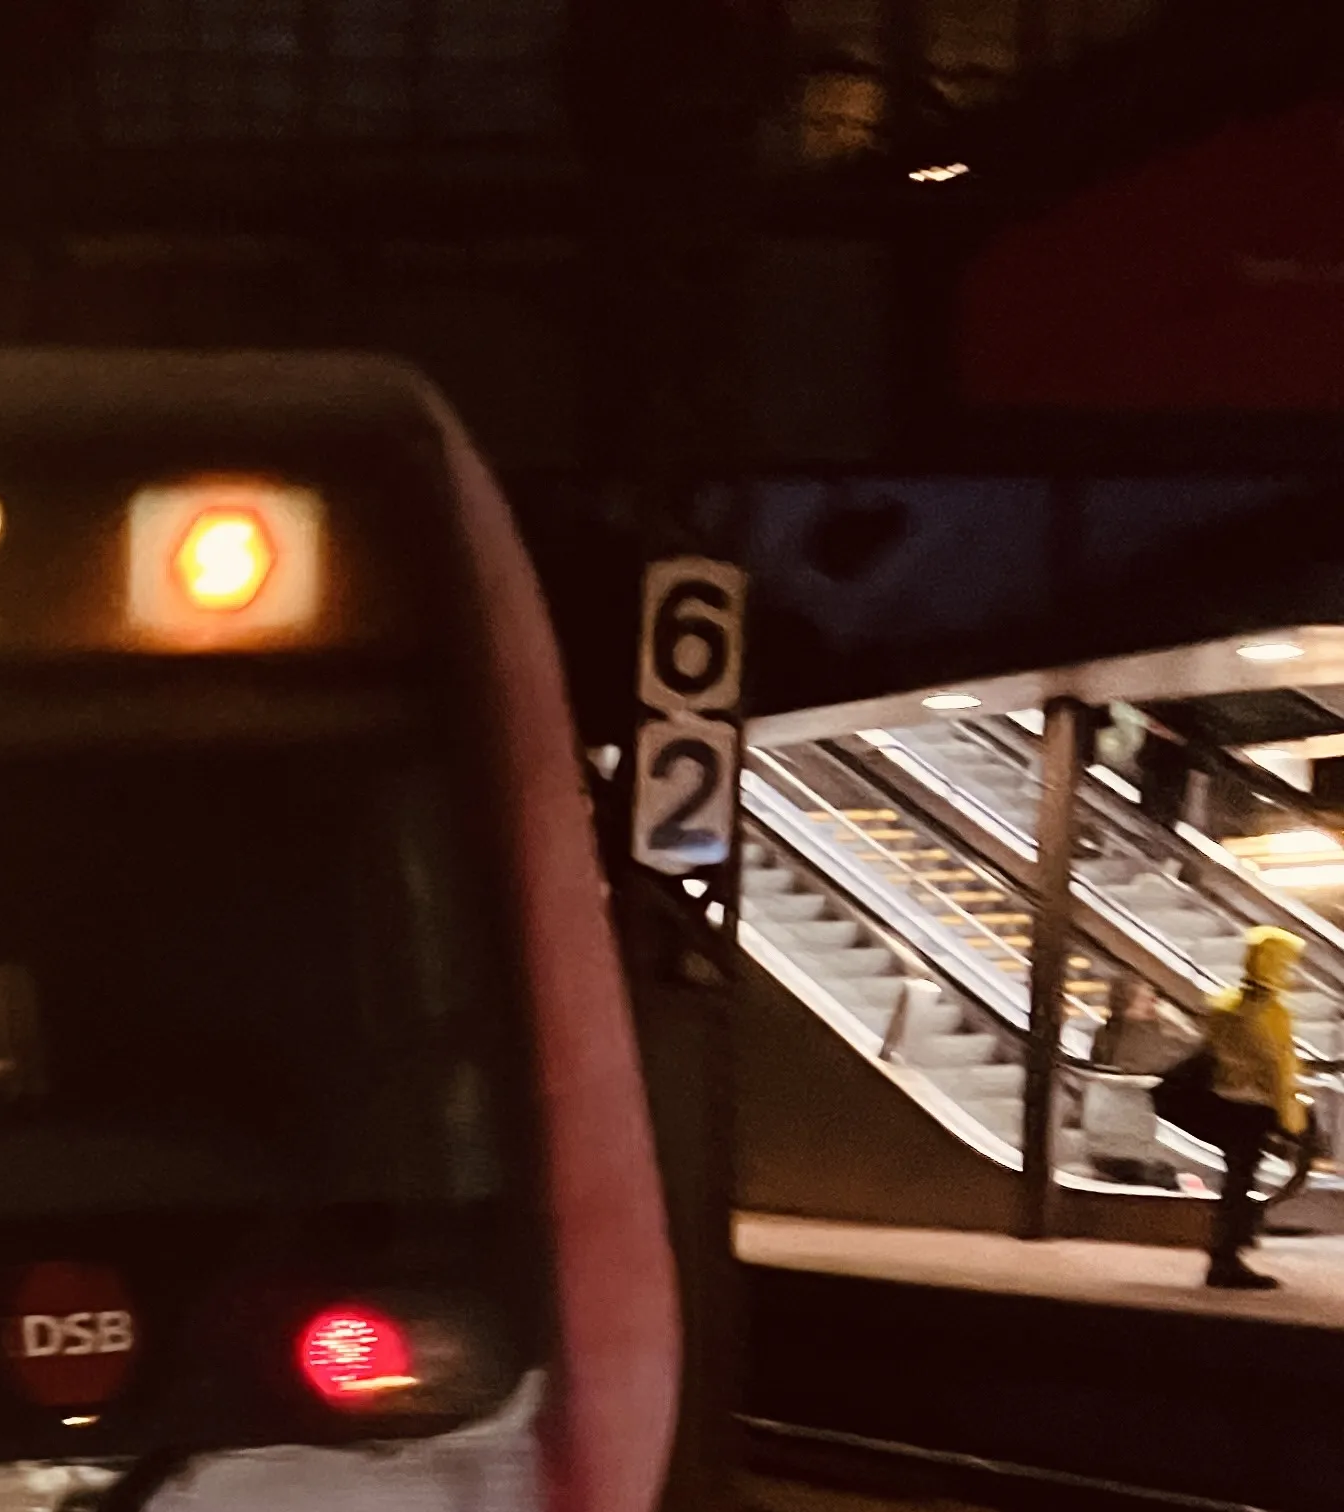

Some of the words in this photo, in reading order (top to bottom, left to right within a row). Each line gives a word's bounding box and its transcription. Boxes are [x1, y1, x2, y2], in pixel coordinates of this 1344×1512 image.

[653, 579, 729, 693] 6
[647, 738, 721, 850] 2
[22, 1310, 133, 1358] DSB
